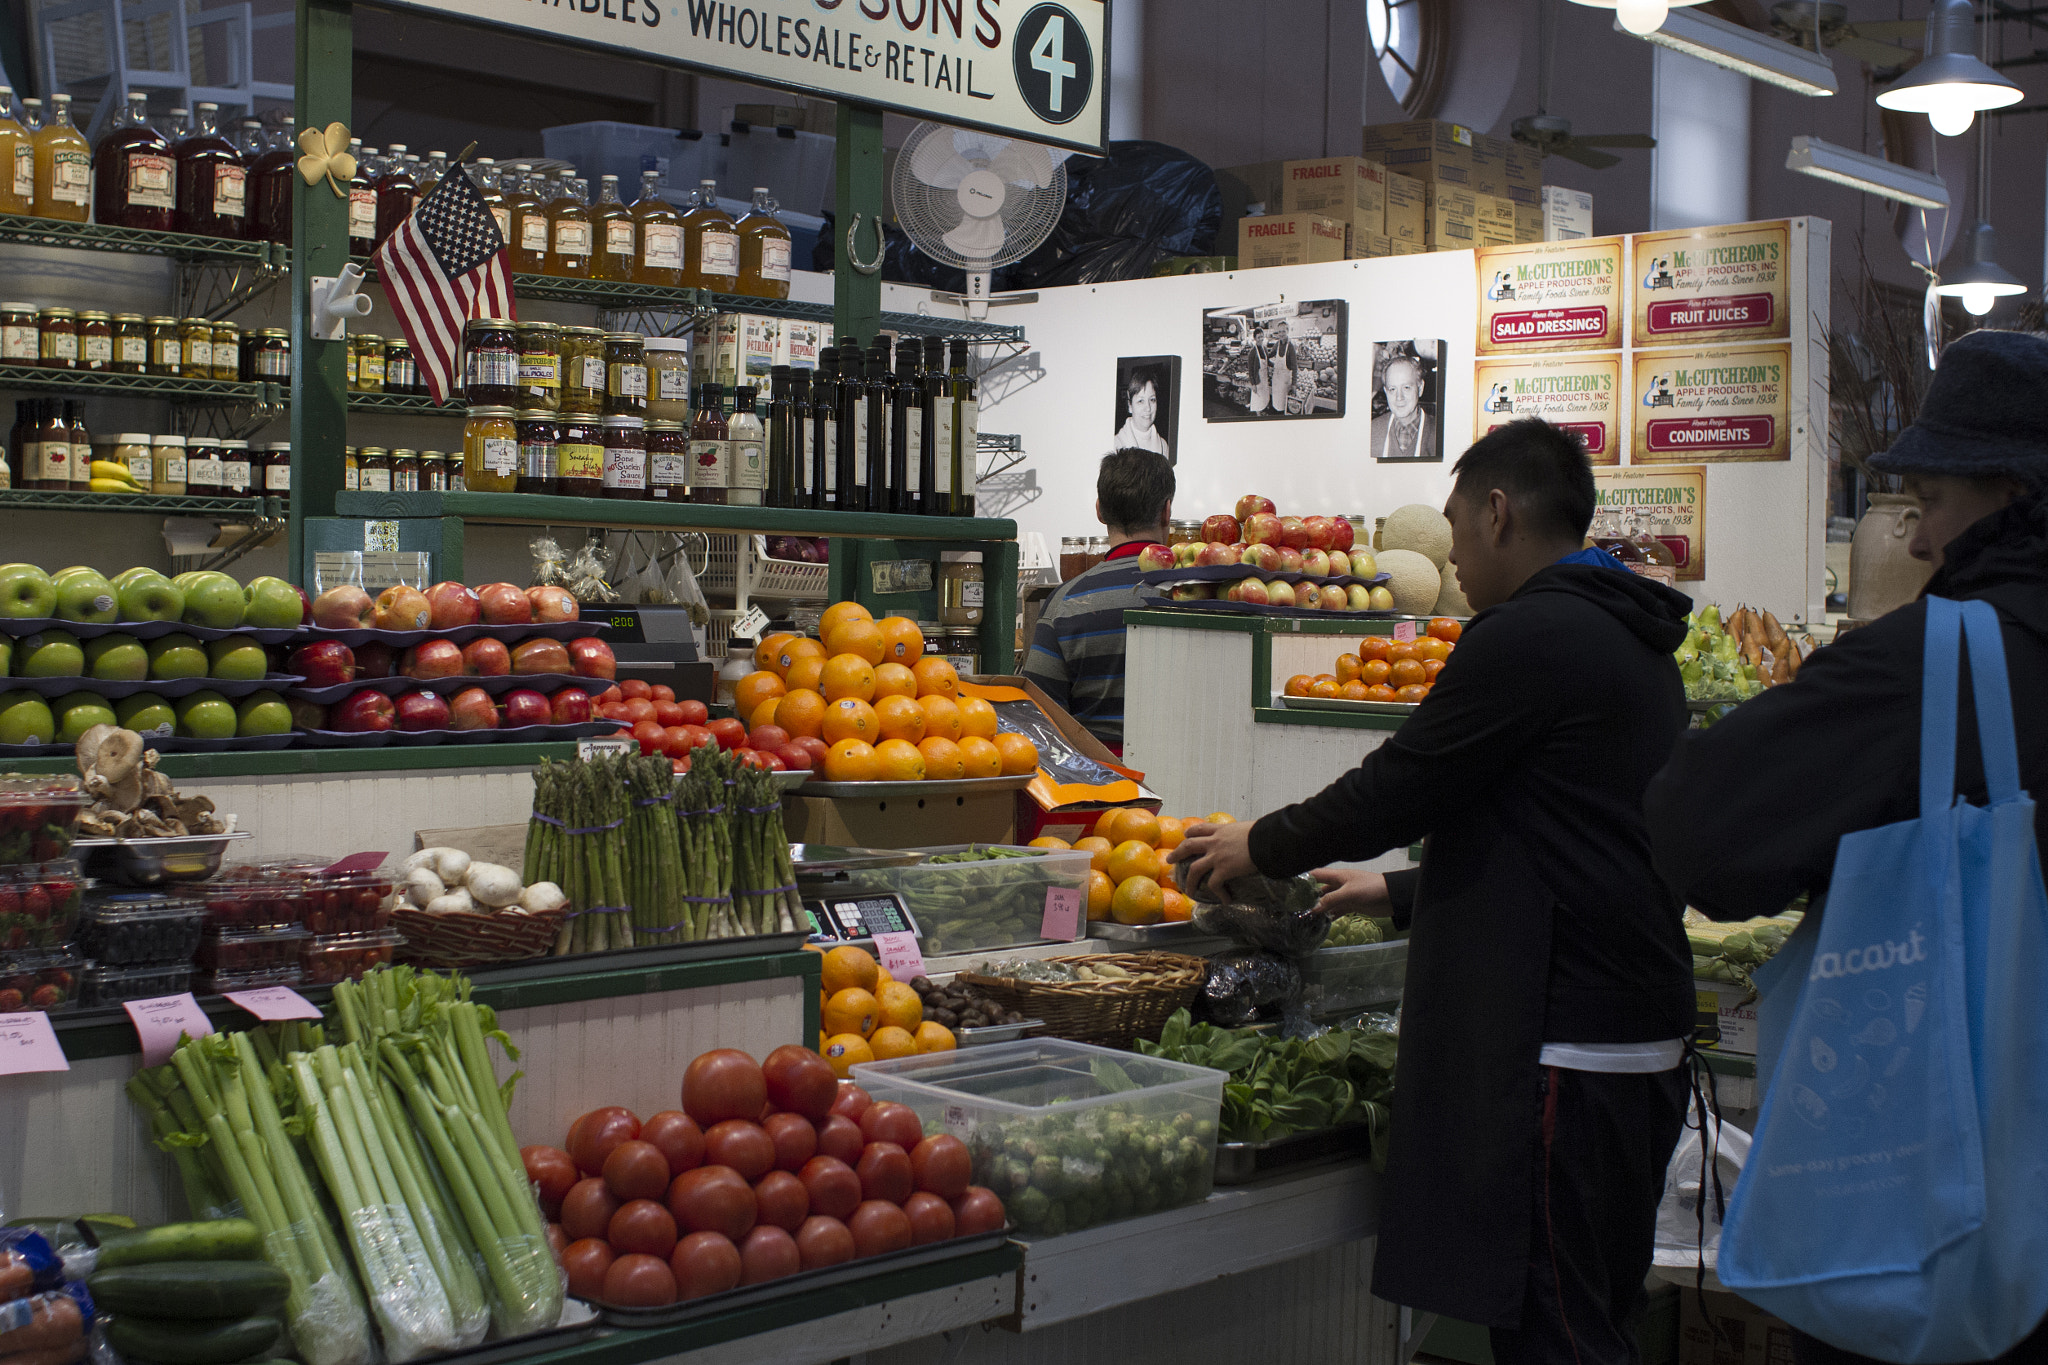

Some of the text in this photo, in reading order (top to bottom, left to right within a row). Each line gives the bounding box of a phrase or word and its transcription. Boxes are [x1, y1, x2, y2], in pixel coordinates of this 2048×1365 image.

[688, 0, 862, 72] WHOLESALE
[865, 44, 881, 67] &
[886, 40, 995, 100] RETAIL
[1030, 14, 1076, 112] 4
[1293, 164, 1342, 180] FRAGILE
[1358, 165, 1384, 184] FRAGILE
[1248, 222, 1296, 238] FRAGILE
[1312, 222, 1342, 240] FRAGILE
[1516, 257, 1614, 281] McCUTCHEON'S
[1707, 264, 1760, 276] PRODUCTS,
[1762, 262, 1778, 271] INC.
[1518, 275, 1613, 290] APPLE PRODUCTS, INC.
[1675, 271, 1778, 292] Family Foods Since 1938
[1517, 285, 1611, 304] Family Foods Since 1938
[1670, 307, 1749, 325] FRUIT JUICES
[1496, 317, 1601, 336] SALAD DRESSINGS
[530, 370, 553, 378] PICKLES
[1675, 364, 1781, 387] McCUTCHEON'S
[1514, 374, 1612, 394] McCUTCHEON'S
[1677, 383, 1780, 397] APPLE PRODUCTS, INC.
[1515, 392, 1611, 403] APPLE PRODUCTS, INC.
[1675, 393, 1778, 412] Family Foods Since 1938
[1515, 401, 1610, 415] Family Foods Since 1938
[1668, 427, 1751, 444] CONDIMENTS
[614, 453, 634, 462] Bone
[607, 463, 617, 473] HOT
[620, 470, 641, 480] Sauce
[1596, 486, 1696, 506] McCUTCHEON'S
[1677, 505, 1695, 514] INC.
[1649, 515, 1694, 526] Since 1938
[583, 743, 621, 752] Asparagus
